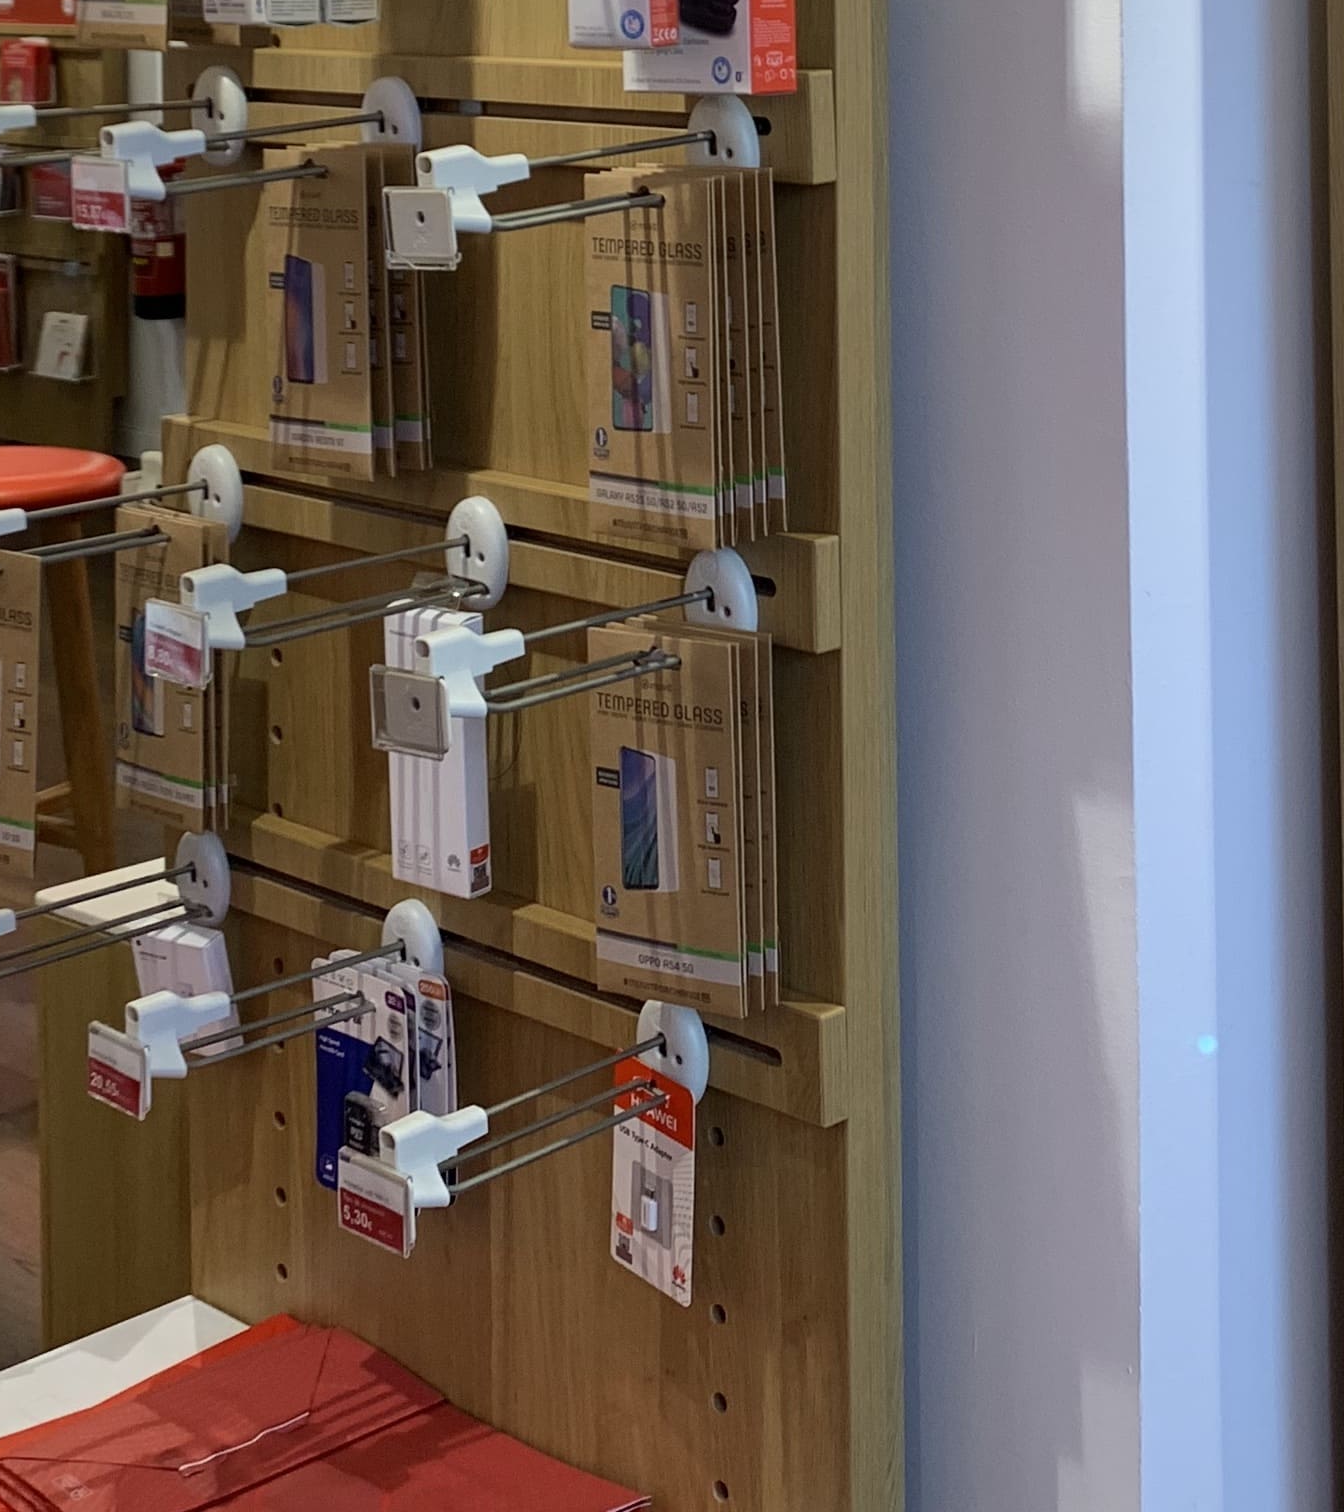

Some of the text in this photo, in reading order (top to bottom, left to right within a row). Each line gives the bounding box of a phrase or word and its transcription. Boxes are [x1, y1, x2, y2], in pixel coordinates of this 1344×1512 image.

[322, 207, 359, 224] GLASS
[591, 236, 704, 260] TEMPERED GLASS
[596, 691, 723, 726] TEMPERED GLASS
[638, 953, 661, 968] OPPO
[630, 1093, 677, 1132] HAWEI
